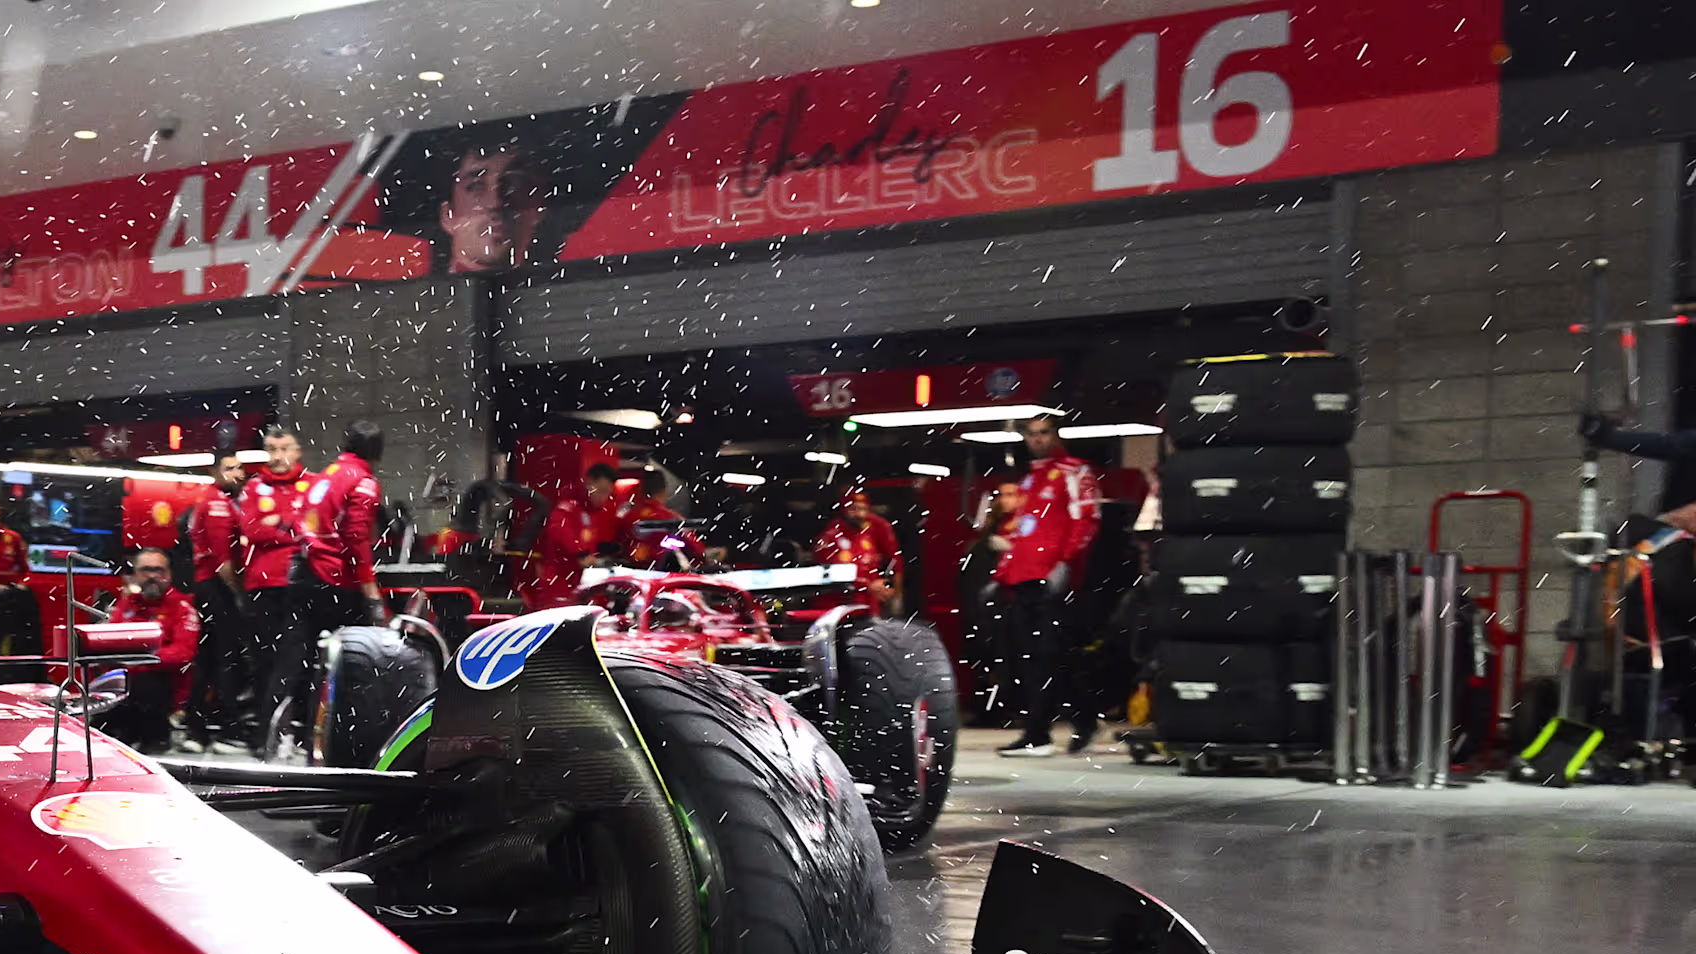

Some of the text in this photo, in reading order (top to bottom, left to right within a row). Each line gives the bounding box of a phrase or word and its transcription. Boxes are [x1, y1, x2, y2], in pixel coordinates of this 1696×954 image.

[1092, 9, 1292, 191] 16
[150, 166, 289, 298] 44
[671, 128, 1038, 233] LECLERC
[811, 378, 853, 410] 16
[374, 904, 458, 918] ACIO
